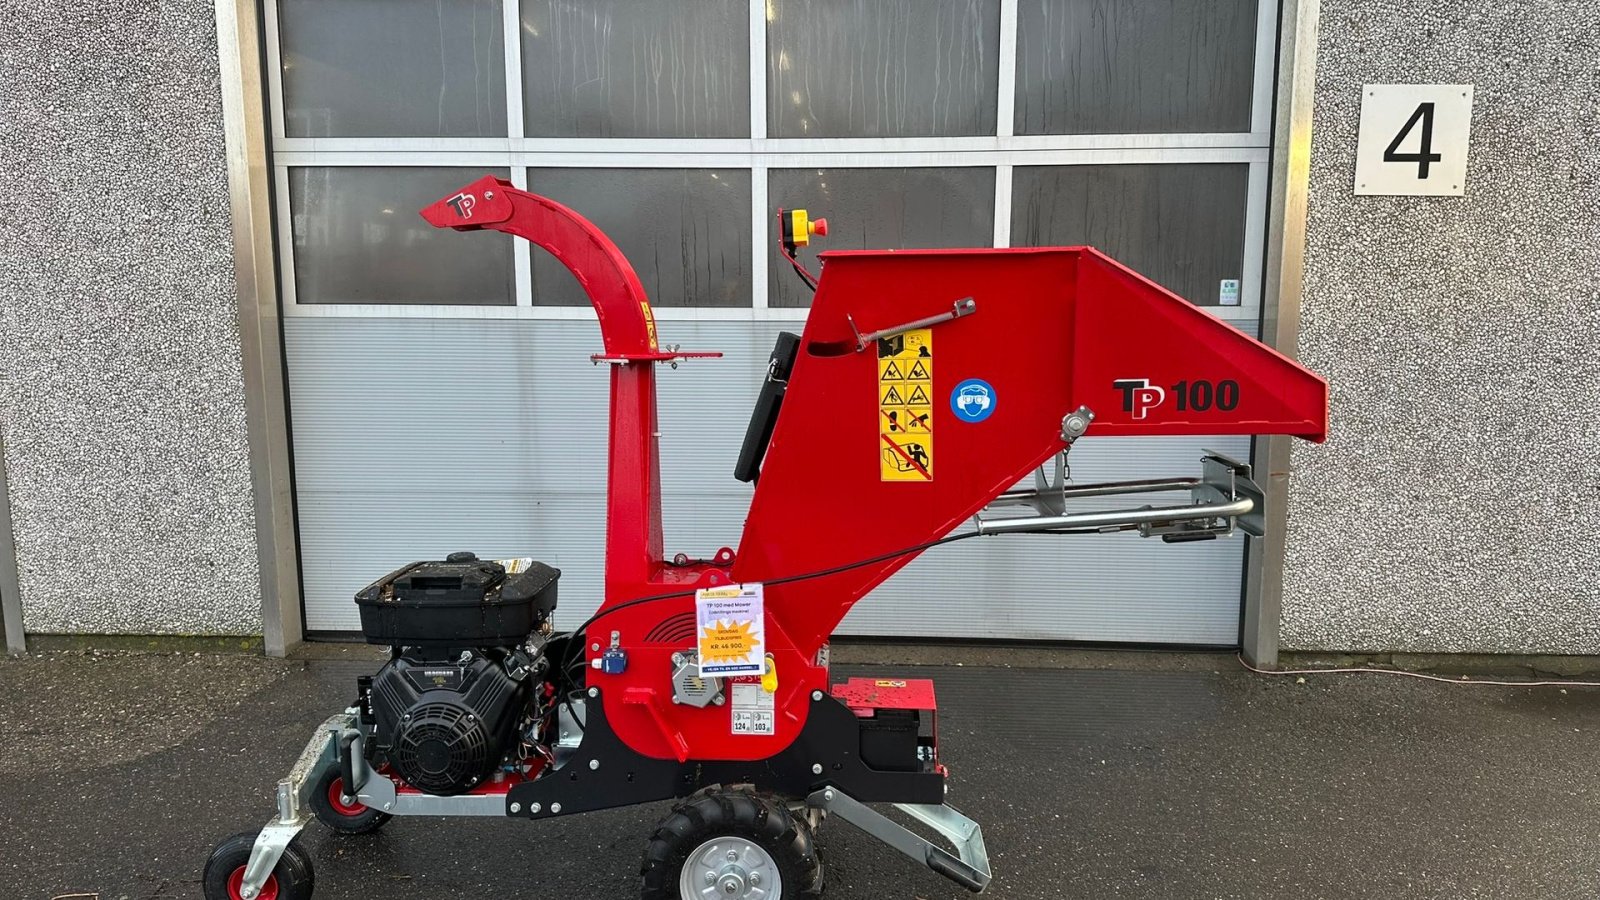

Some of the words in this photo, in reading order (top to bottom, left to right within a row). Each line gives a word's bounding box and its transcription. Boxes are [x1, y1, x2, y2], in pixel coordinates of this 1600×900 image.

[1383, 102, 1442, 180] 4
[446, 192, 476, 219] TP
[1112, 378, 1166, 420] TP
[1171, 379, 1240, 412] 100
[755, 723, 766, 731] 103
